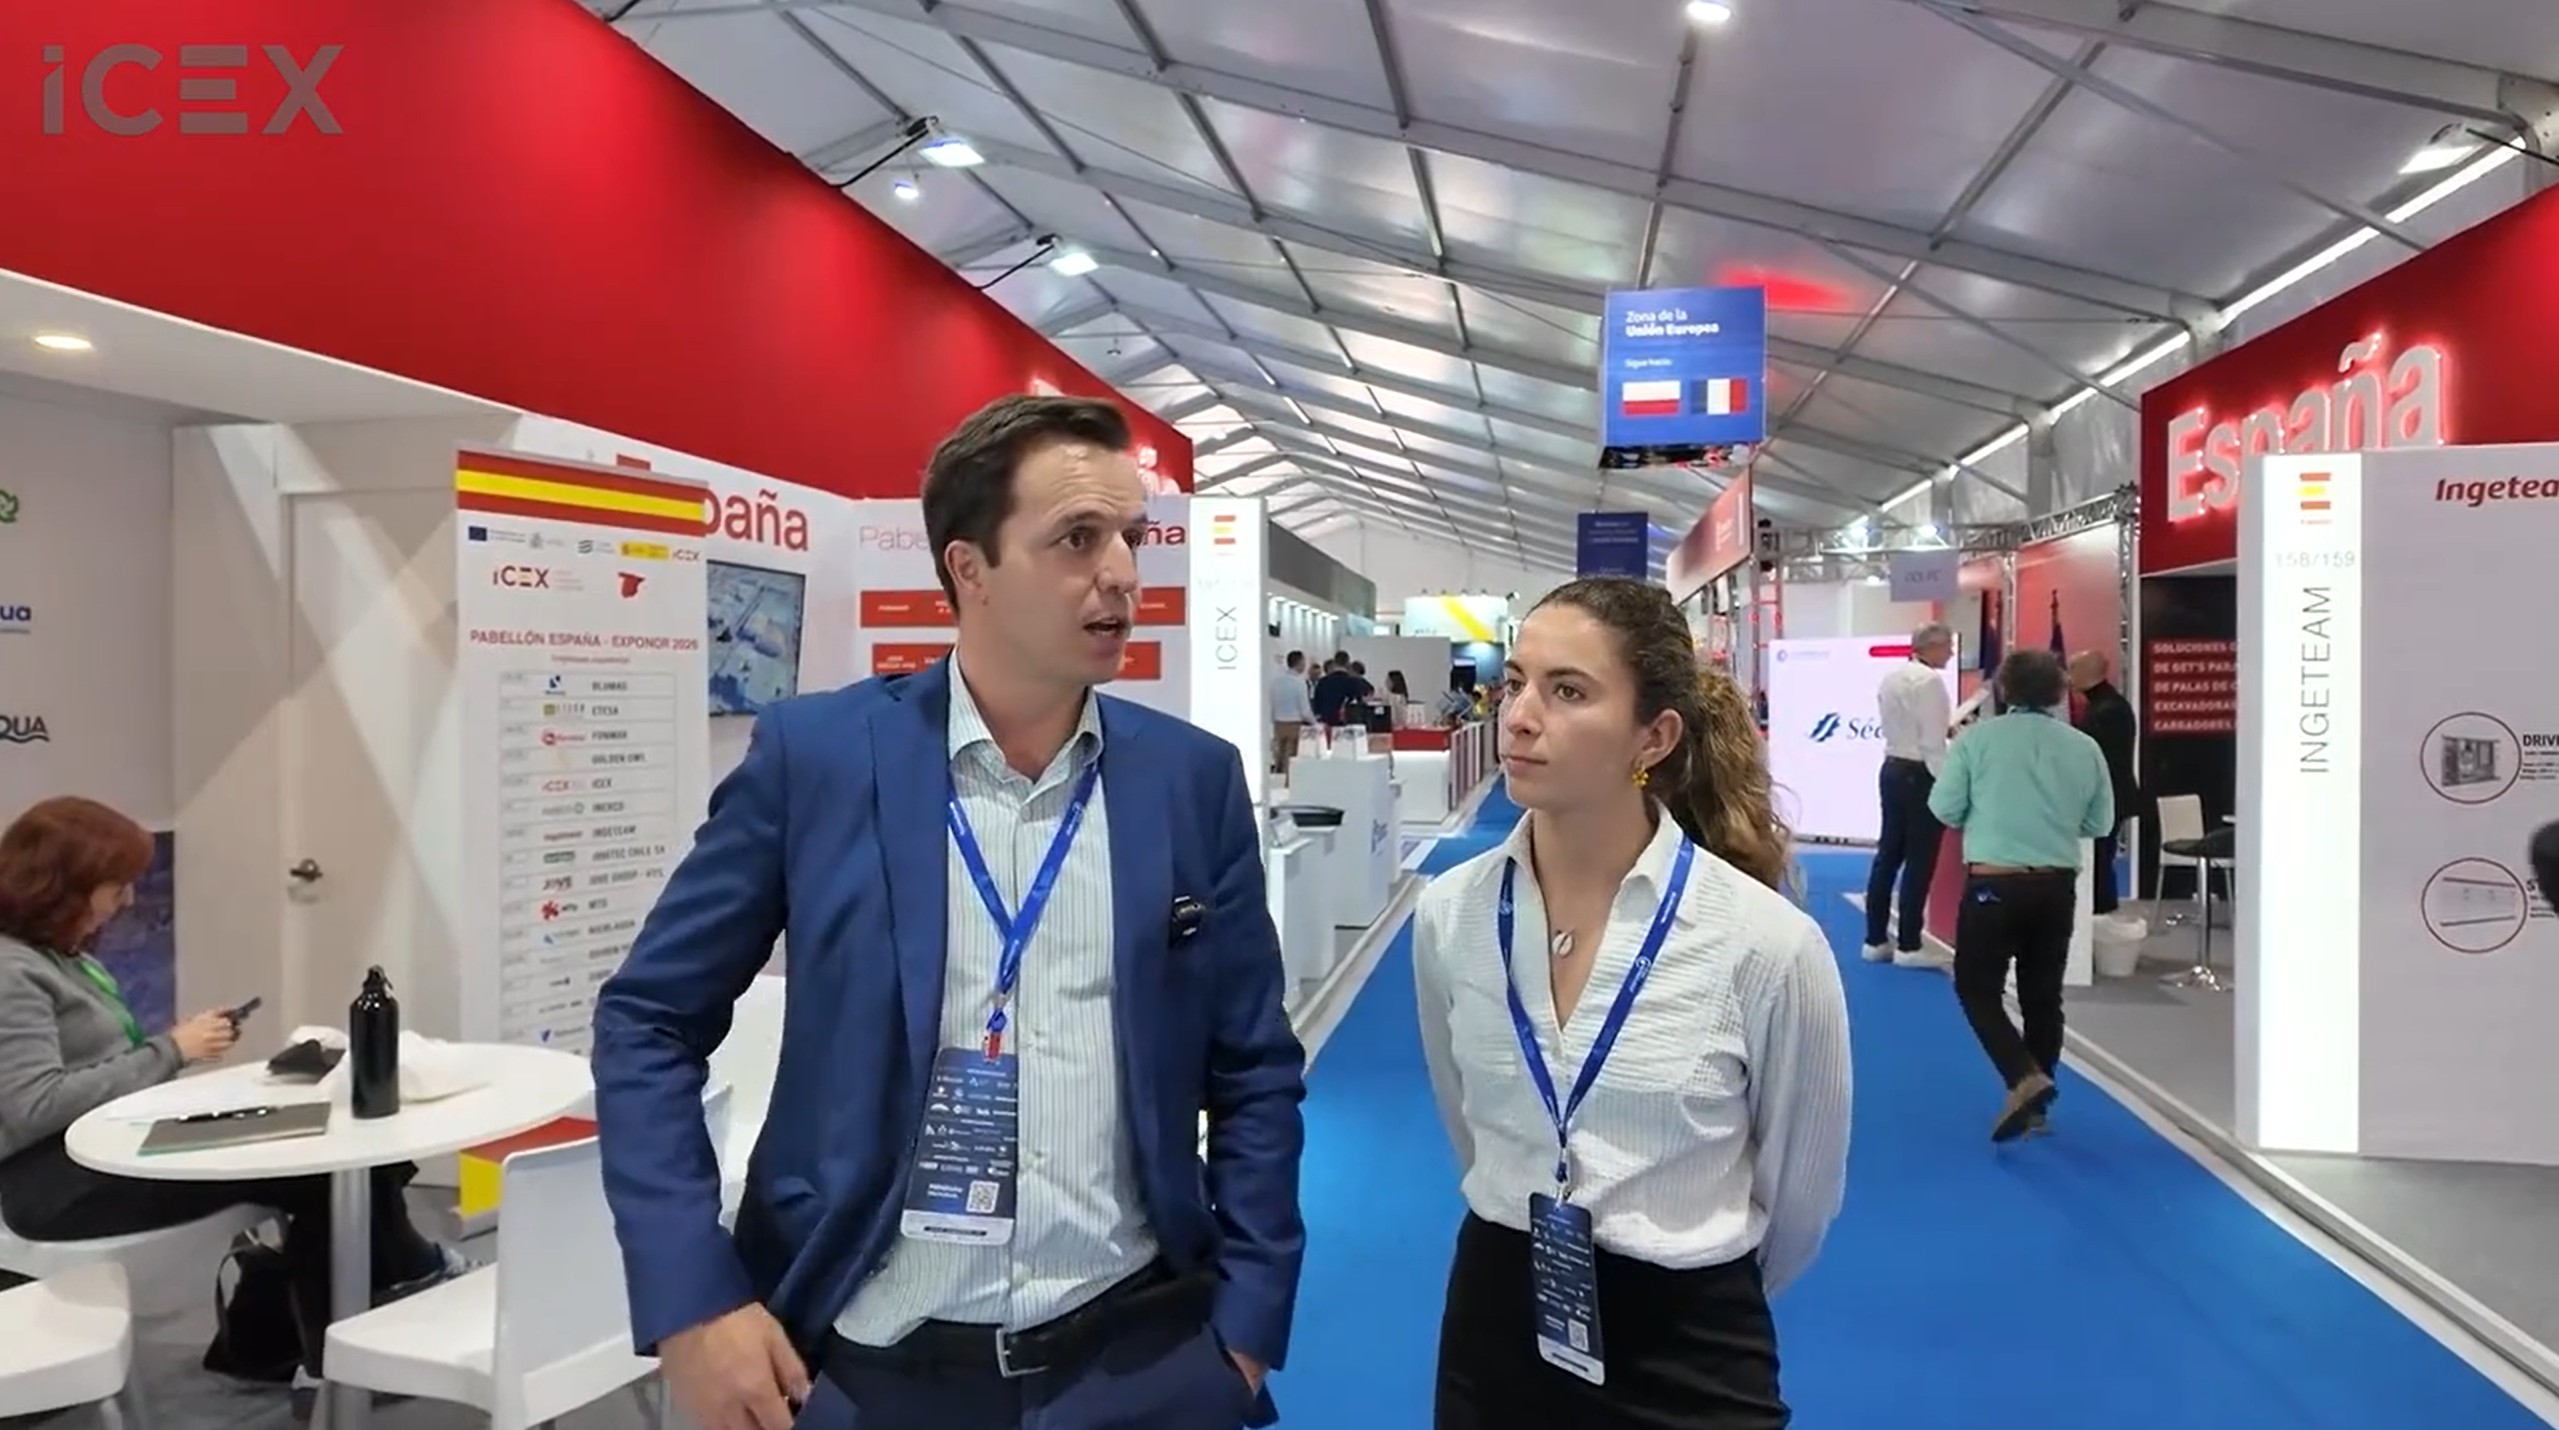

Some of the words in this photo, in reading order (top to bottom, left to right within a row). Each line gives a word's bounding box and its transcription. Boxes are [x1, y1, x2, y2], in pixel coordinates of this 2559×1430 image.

[1625, 310, 1656, 323] Zona
[1658, 309, 1673, 321] de
[1675, 308, 1688, 320] la
[1625, 322, 1664, 336] Unión
[1666, 323, 1719, 336] Europea
[2168, 333, 2443, 521] España
[470, 629, 545, 646] PABELLÓN
[549, 631, 601, 647] ESPAÑA
[611, 635, 670, 650] EXPONOR
[1216, 606, 1238, 670] ICEX
[2299, 587, 2332, 774] INGETEAM
